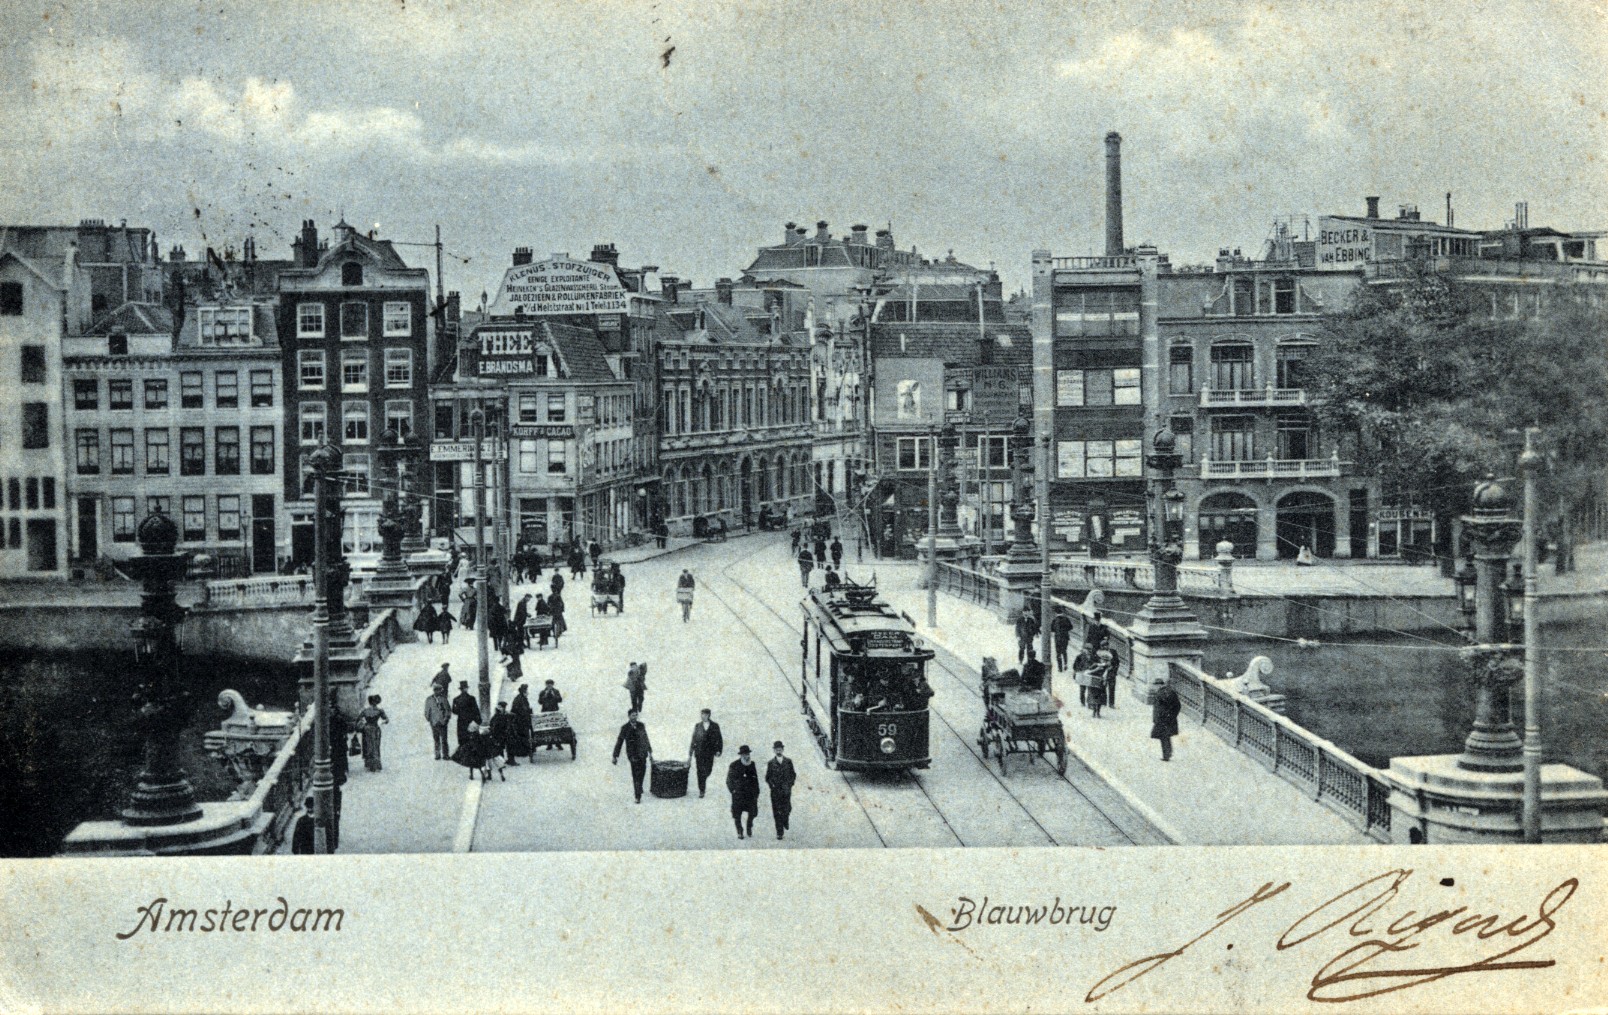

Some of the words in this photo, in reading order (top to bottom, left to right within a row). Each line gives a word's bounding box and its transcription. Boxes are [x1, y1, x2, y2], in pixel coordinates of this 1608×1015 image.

[1321, 229, 1359, 245] BECKER
[1361, 229, 1369, 242] &
[509, 264, 546, 282] KLENUS
[552, 262, 611, 282] STOFZUIGER
[551, 274, 590, 283] EXPLOITANTE
[557, 291, 626, 301] ROLLUIKENFABRIEK
[477, 331, 533, 355] THEE
[546, 427, 572, 436] CACAO
[878, 723, 897, 736] 59
